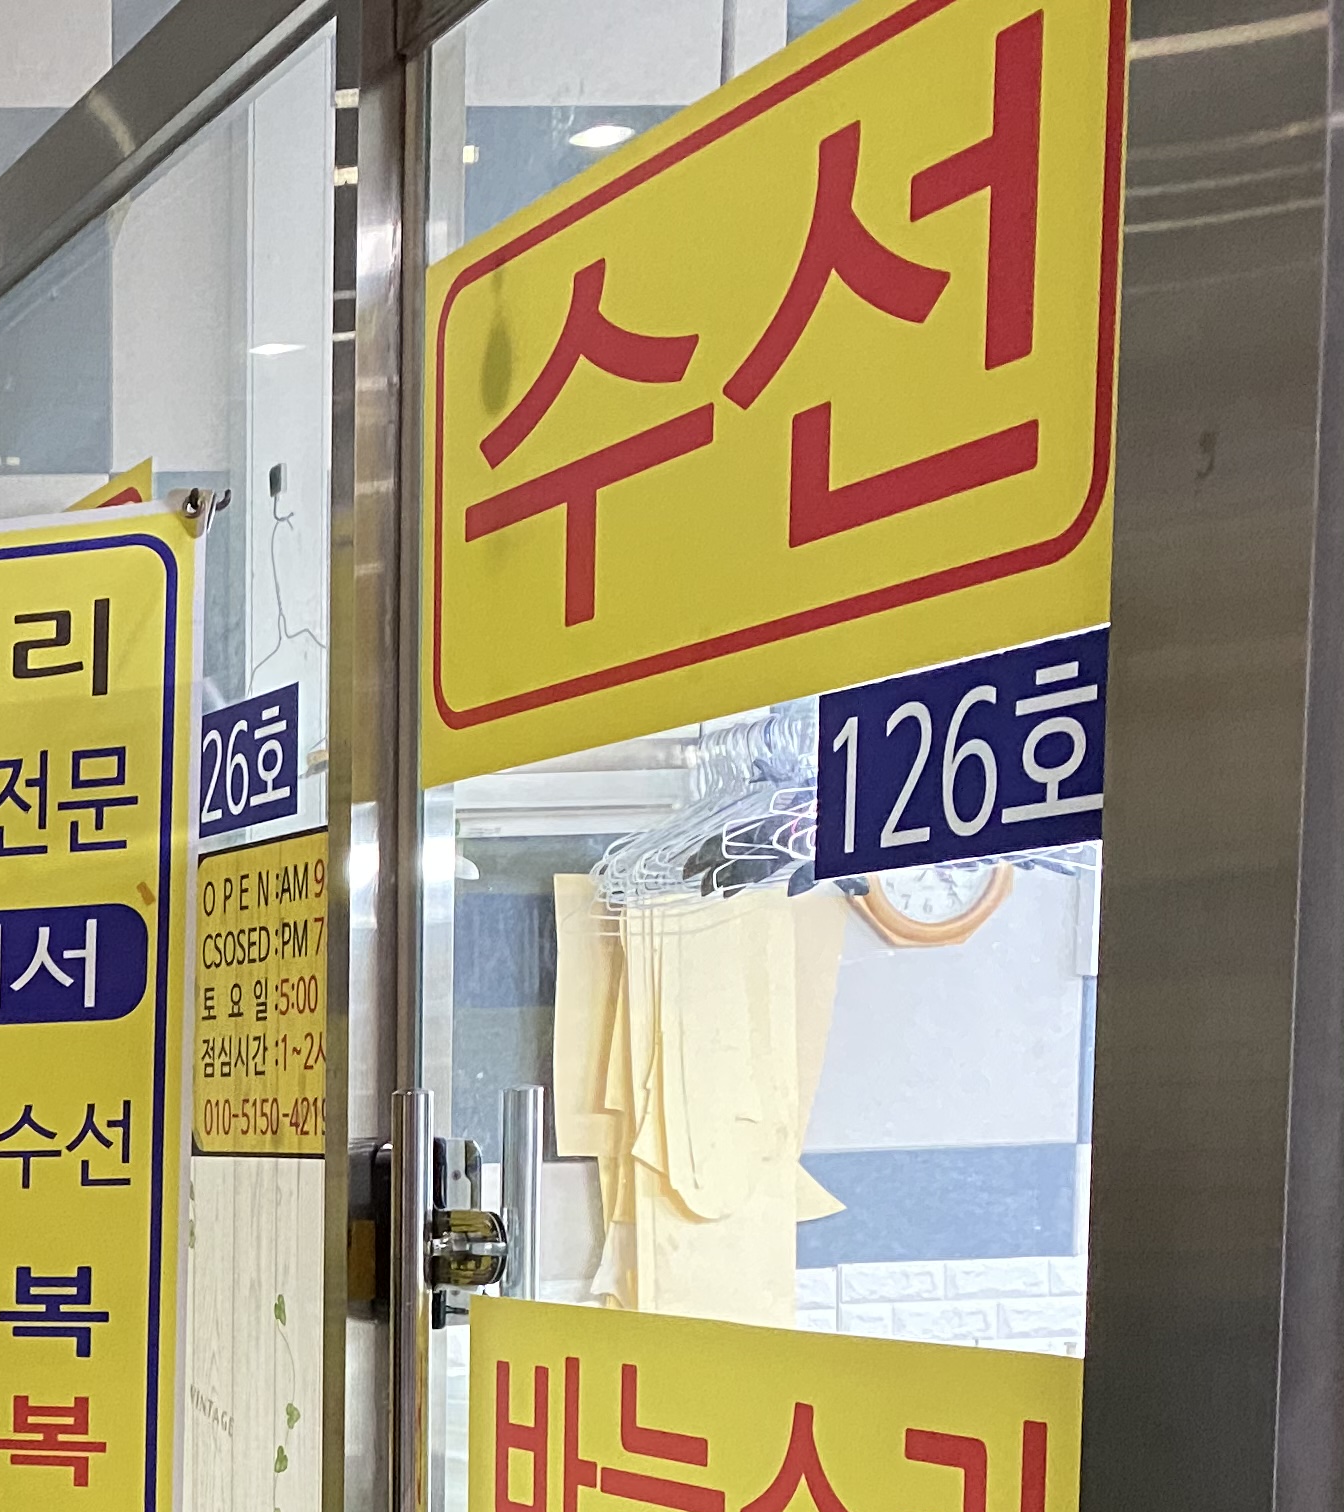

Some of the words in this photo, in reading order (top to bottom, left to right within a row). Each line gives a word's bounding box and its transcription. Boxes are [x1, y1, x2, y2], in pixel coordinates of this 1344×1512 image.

[465, 8, 1044, 627] 수선
[831, 660, 1105, 856] 126호
[201, 1032, 269, 1078] 점심시간
[203, 1096, 326, 1137] 010-5150-421
